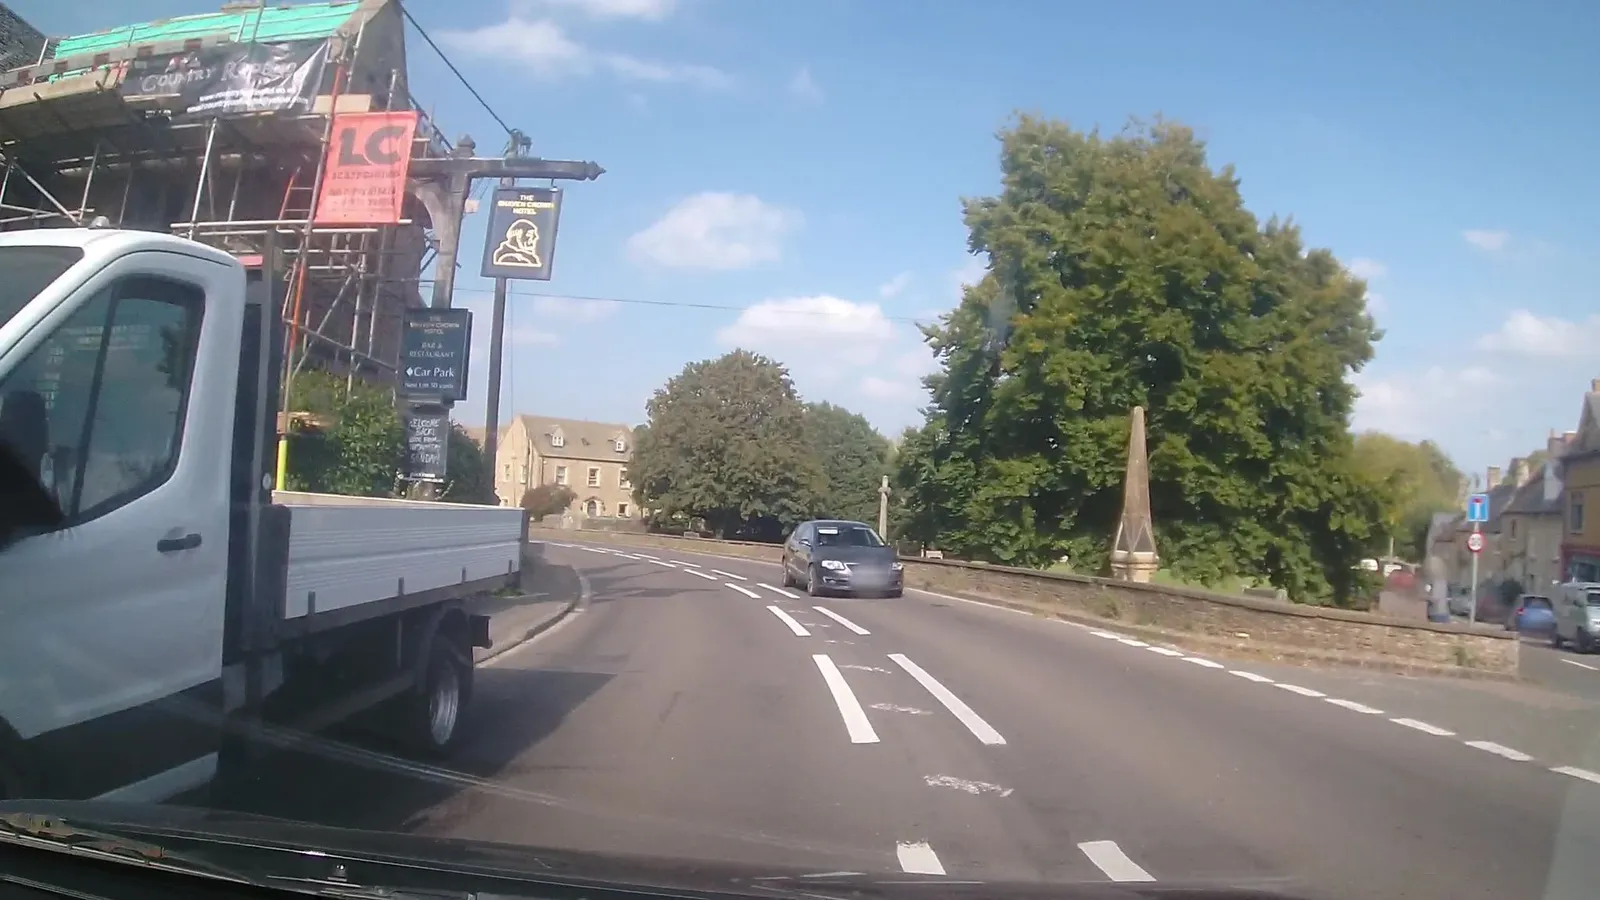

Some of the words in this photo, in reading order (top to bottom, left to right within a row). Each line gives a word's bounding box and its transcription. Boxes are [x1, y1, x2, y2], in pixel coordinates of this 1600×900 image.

[141, 67, 216, 92] COUNTRY
[338, 126, 406, 166] LC
[332, 170, 400, 180] SCAFFOI
[414, 366, 430, 377] Car
[434, 366, 454, 378] Park
